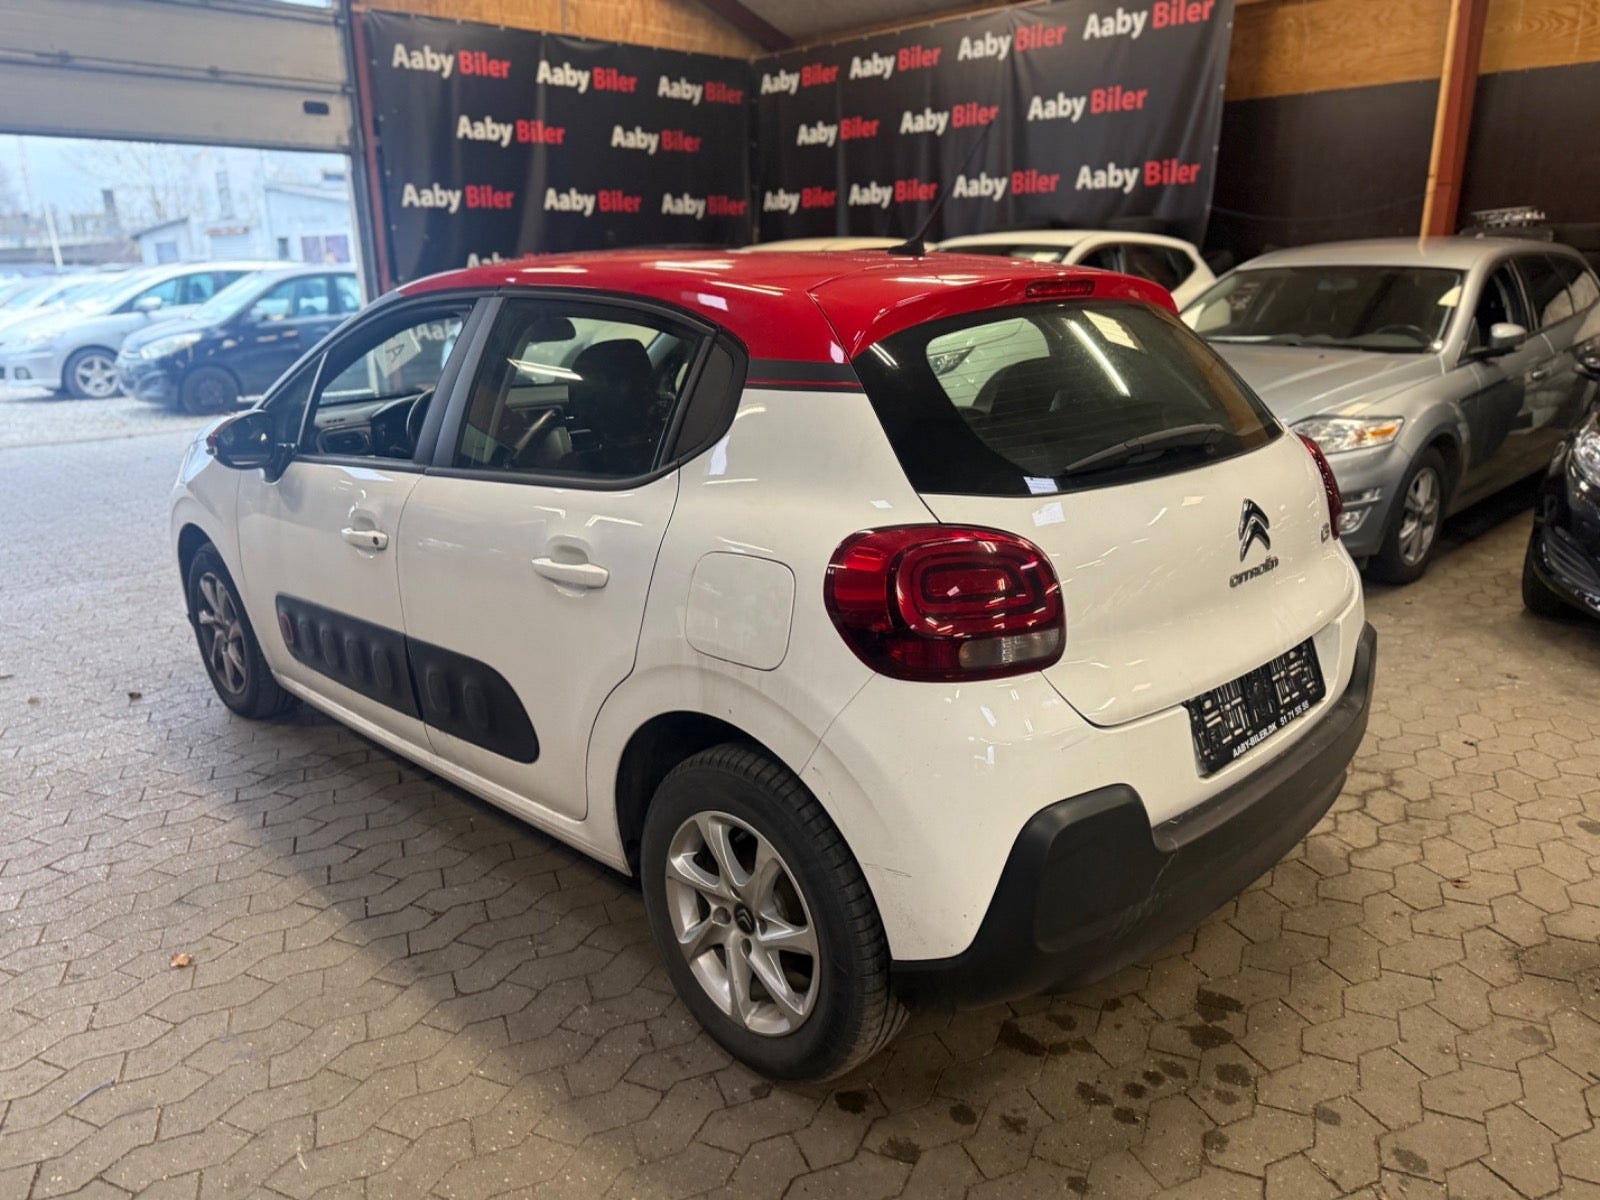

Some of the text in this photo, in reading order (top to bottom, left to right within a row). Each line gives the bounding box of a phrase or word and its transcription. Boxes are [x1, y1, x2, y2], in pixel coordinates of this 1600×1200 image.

[1083, 0, 1215, 40] Aaby Biler
[958, 23, 1066, 60] Aaby Biler
[392, 43, 510, 78] Aaby Biler
[850, 46, 941, 79] Aaby Biler
[537, 60, 637, 93] Aaby Biler
[658, 76, 743, 105] Aaby Biler
[761, 64, 838, 94] Aaby Biler
[900, 102, 999, 135] Aaby Biler
[1028, 85, 1147, 122] Aaby Biler
[457, 115, 565, 147] Aaby Biler
[612, 126, 700, 154] Aaby Biler
[797, 117, 879, 147] Aaby Biler
[953, 170, 1059, 201] Aaby Biler
[1075, 159, 1200, 193] Aaby Biler
[402, 183, 513, 213] Aaby Biler
[544, 188, 641, 216] Aaby Biler
[662, 193, 746, 219] Aaby Biler
[802, 187, 836, 208] Biler
[849, 179, 937, 208] Aaby Biler
[1232, 721, 1278, 758] AABY-BILER.DK
